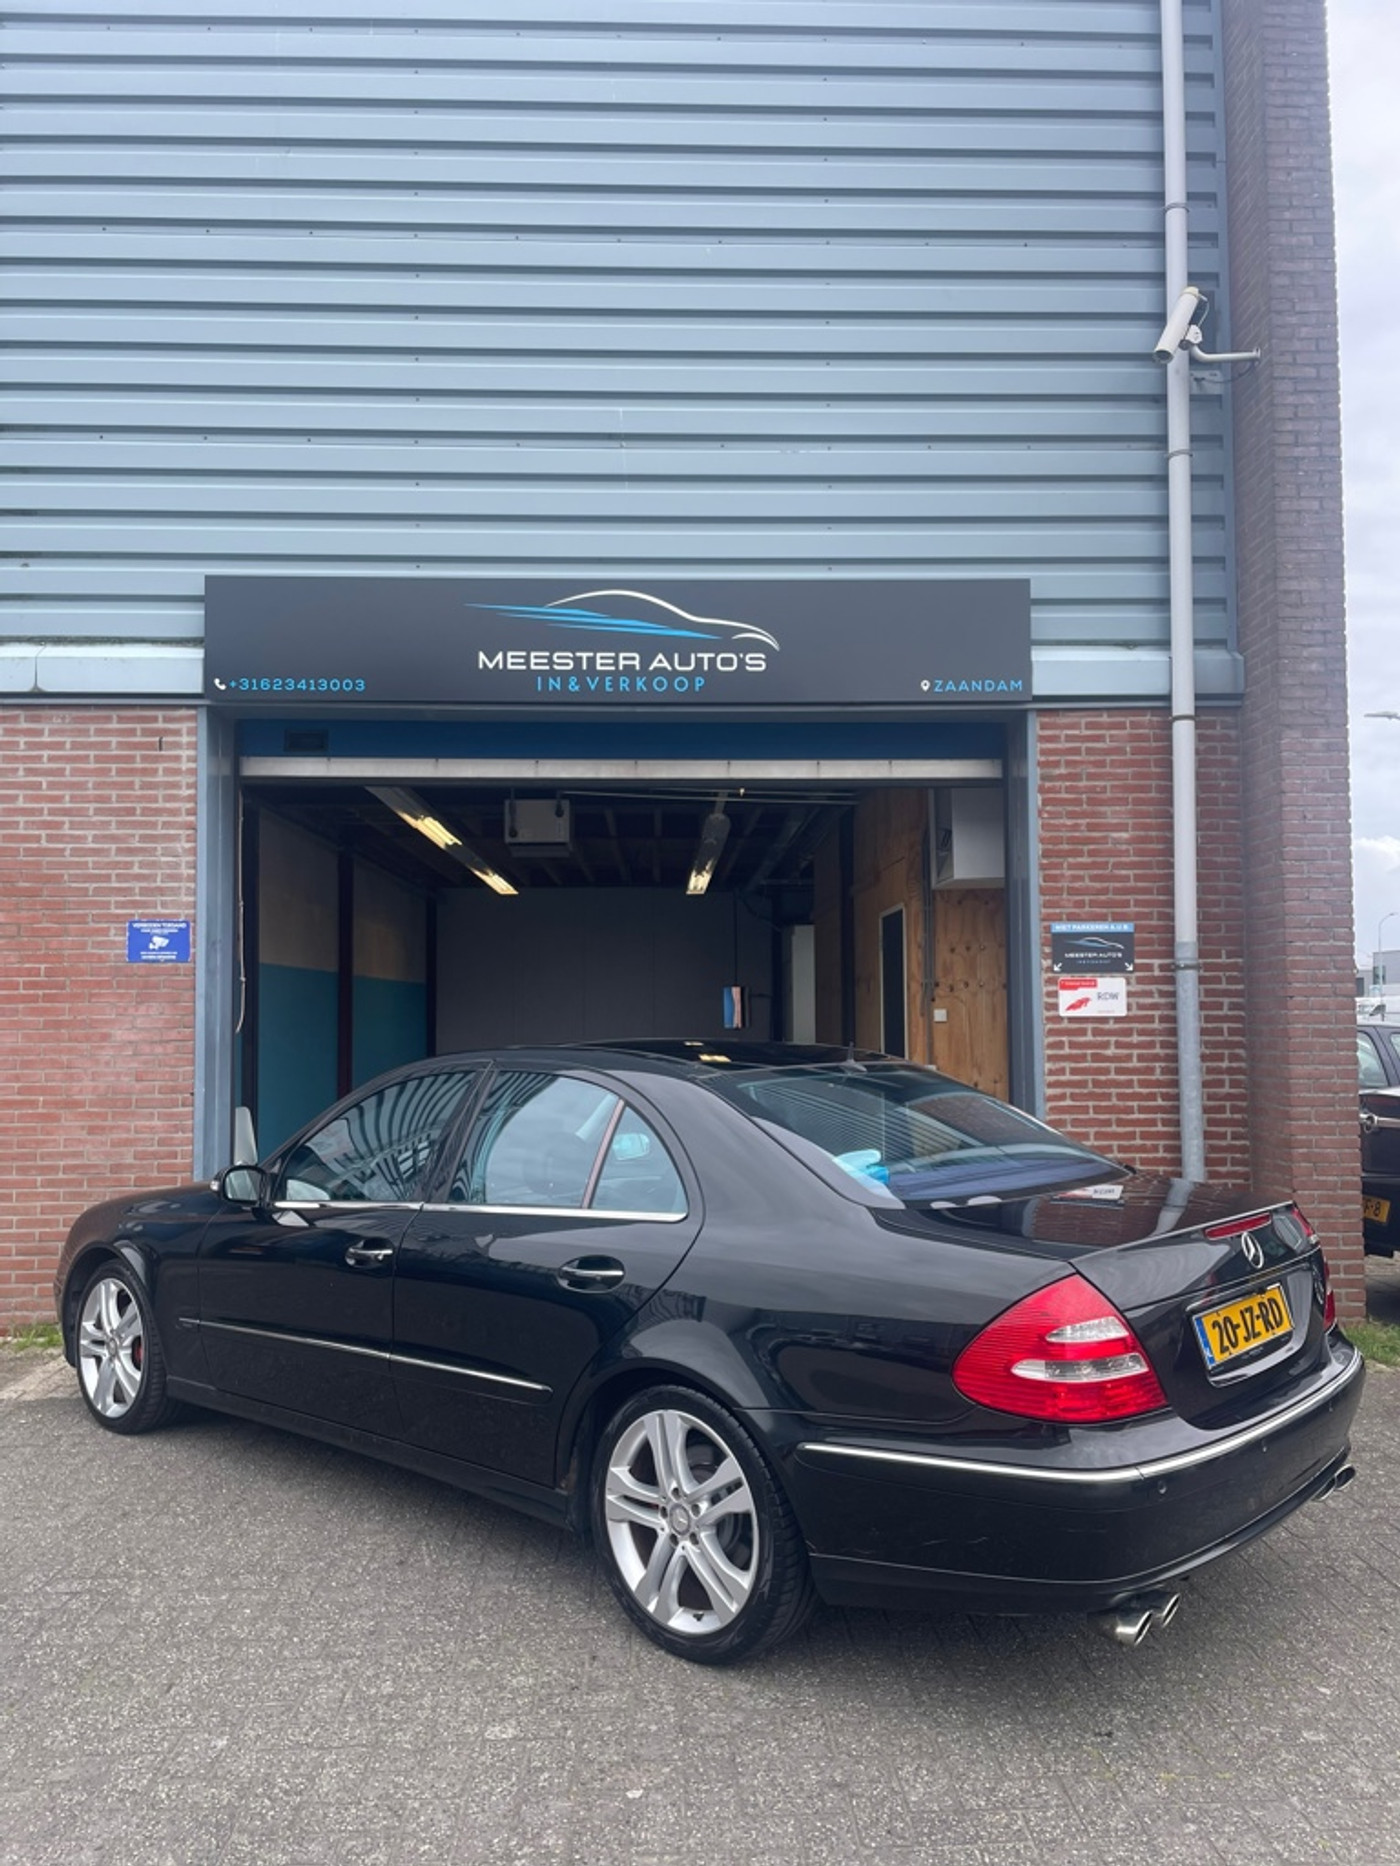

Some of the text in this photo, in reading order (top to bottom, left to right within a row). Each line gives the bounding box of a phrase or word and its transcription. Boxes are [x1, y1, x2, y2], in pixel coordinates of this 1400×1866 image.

[478, 651, 767, 672] MEESTER AUTO'S
[229, 678, 366, 691] +31623413003
[933, 679, 1023, 692] ZAANDAM
[1212, 1297, 1284, 1355] 20-JZ-RD
